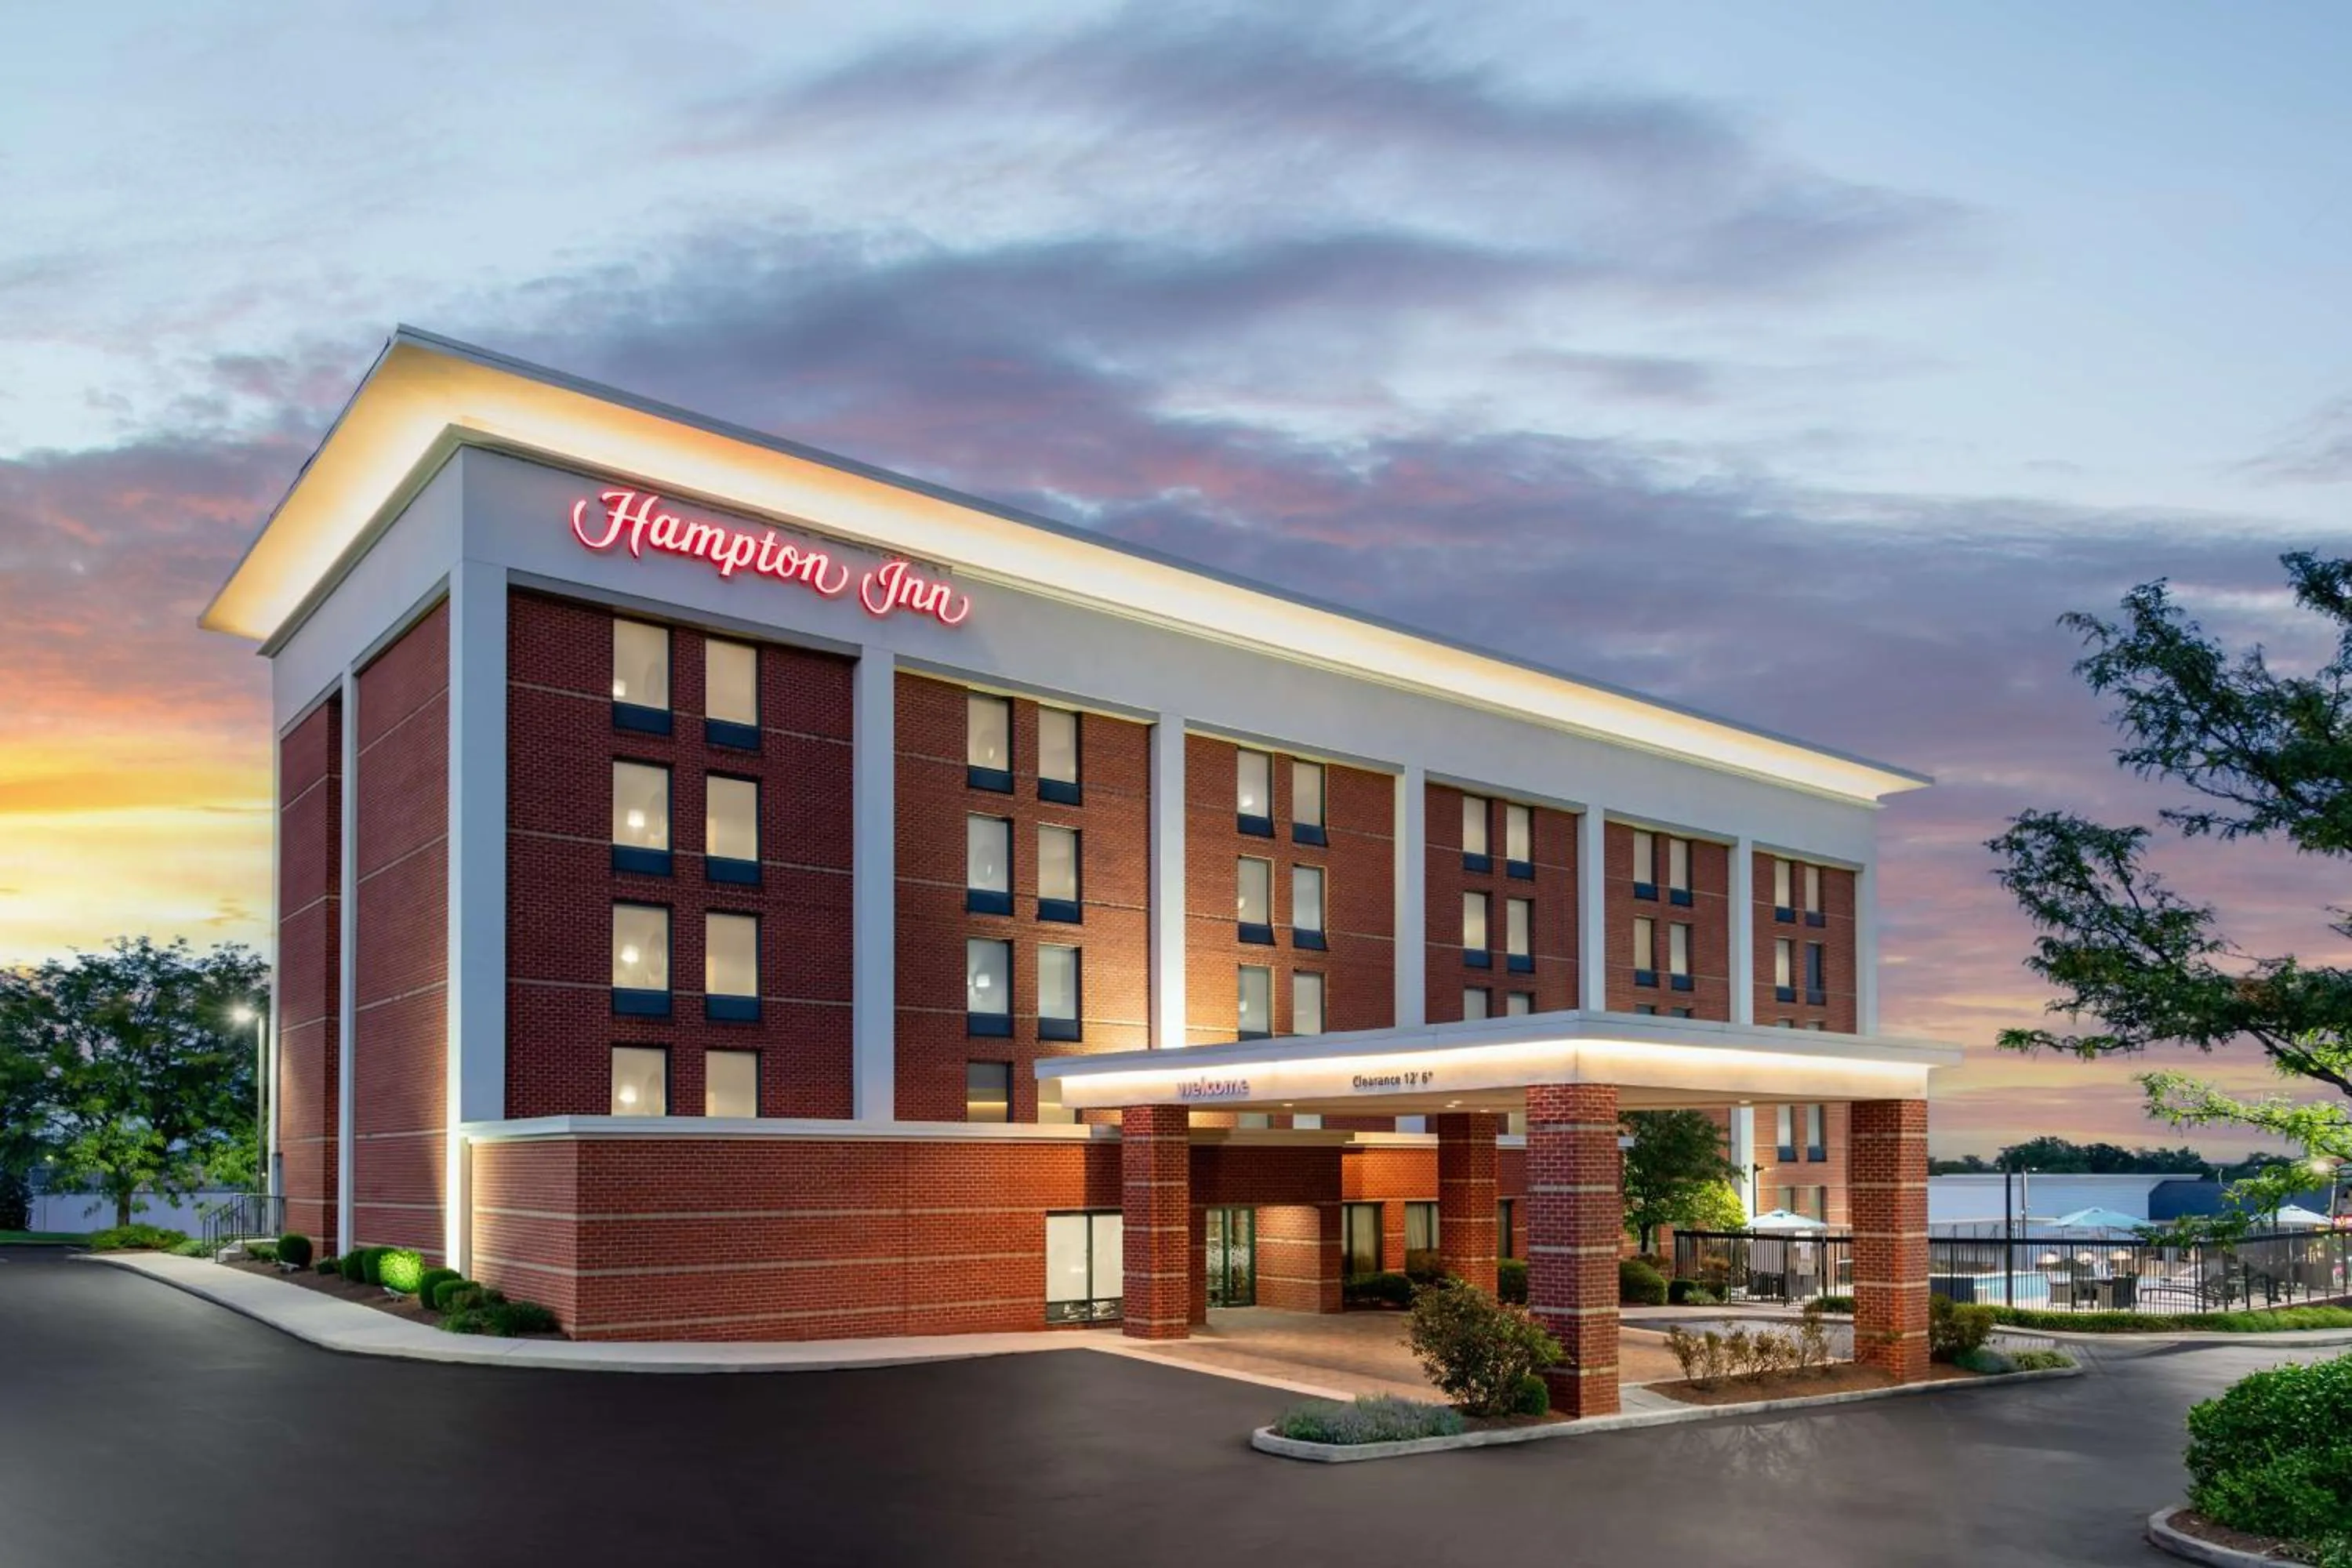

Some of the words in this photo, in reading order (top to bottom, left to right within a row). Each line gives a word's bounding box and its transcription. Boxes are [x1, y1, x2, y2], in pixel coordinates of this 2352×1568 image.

[572, 491, 849, 595] Hampton
[861, 560, 970, 624] Inn
[1177, 1076, 1250, 1097] welcome
[1352, 1074, 1400, 1087] Clearance
[1404, 1072, 1418, 1084] 12'
